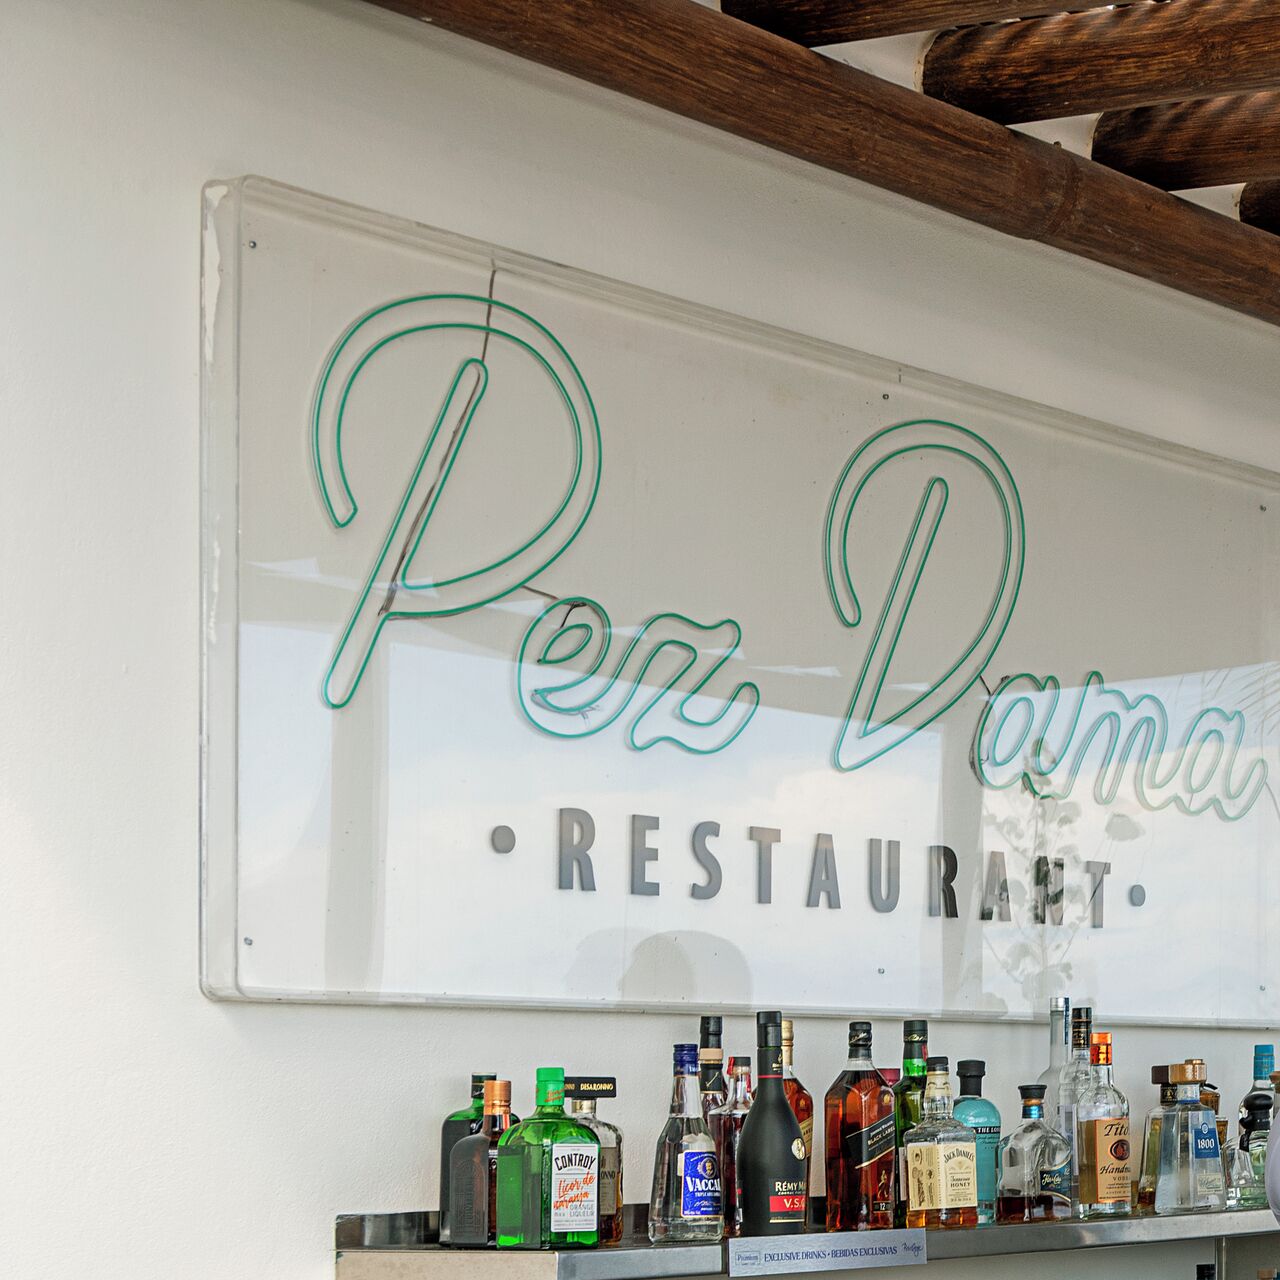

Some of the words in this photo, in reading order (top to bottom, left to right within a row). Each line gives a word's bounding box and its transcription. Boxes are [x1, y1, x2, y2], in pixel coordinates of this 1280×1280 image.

[309, 292, 760, 755] Pez
[823, 418, 1268, 823] Dama
[556, 806, 1113, 931] RESTAURANT
[580, 1082, 614, 1091] DESARONNO
[1104, 1121, 1130, 1137] Tito
[1197, 1139, 1215, 1149] 1800
[554, 1153, 596, 1171] CONTROY
[944, 1150, 956, 1164] JACK
[775, 1181, 798, 1192] RÉMY
[764, 1251, 801, 1263] EXCLUSIVE
[801, 1250, 827, 1261] DRINKS
[831, 1249, 859, 1259] BEBIDAS
[859, 1246, 898, 1257] EXCLUSIVAS
